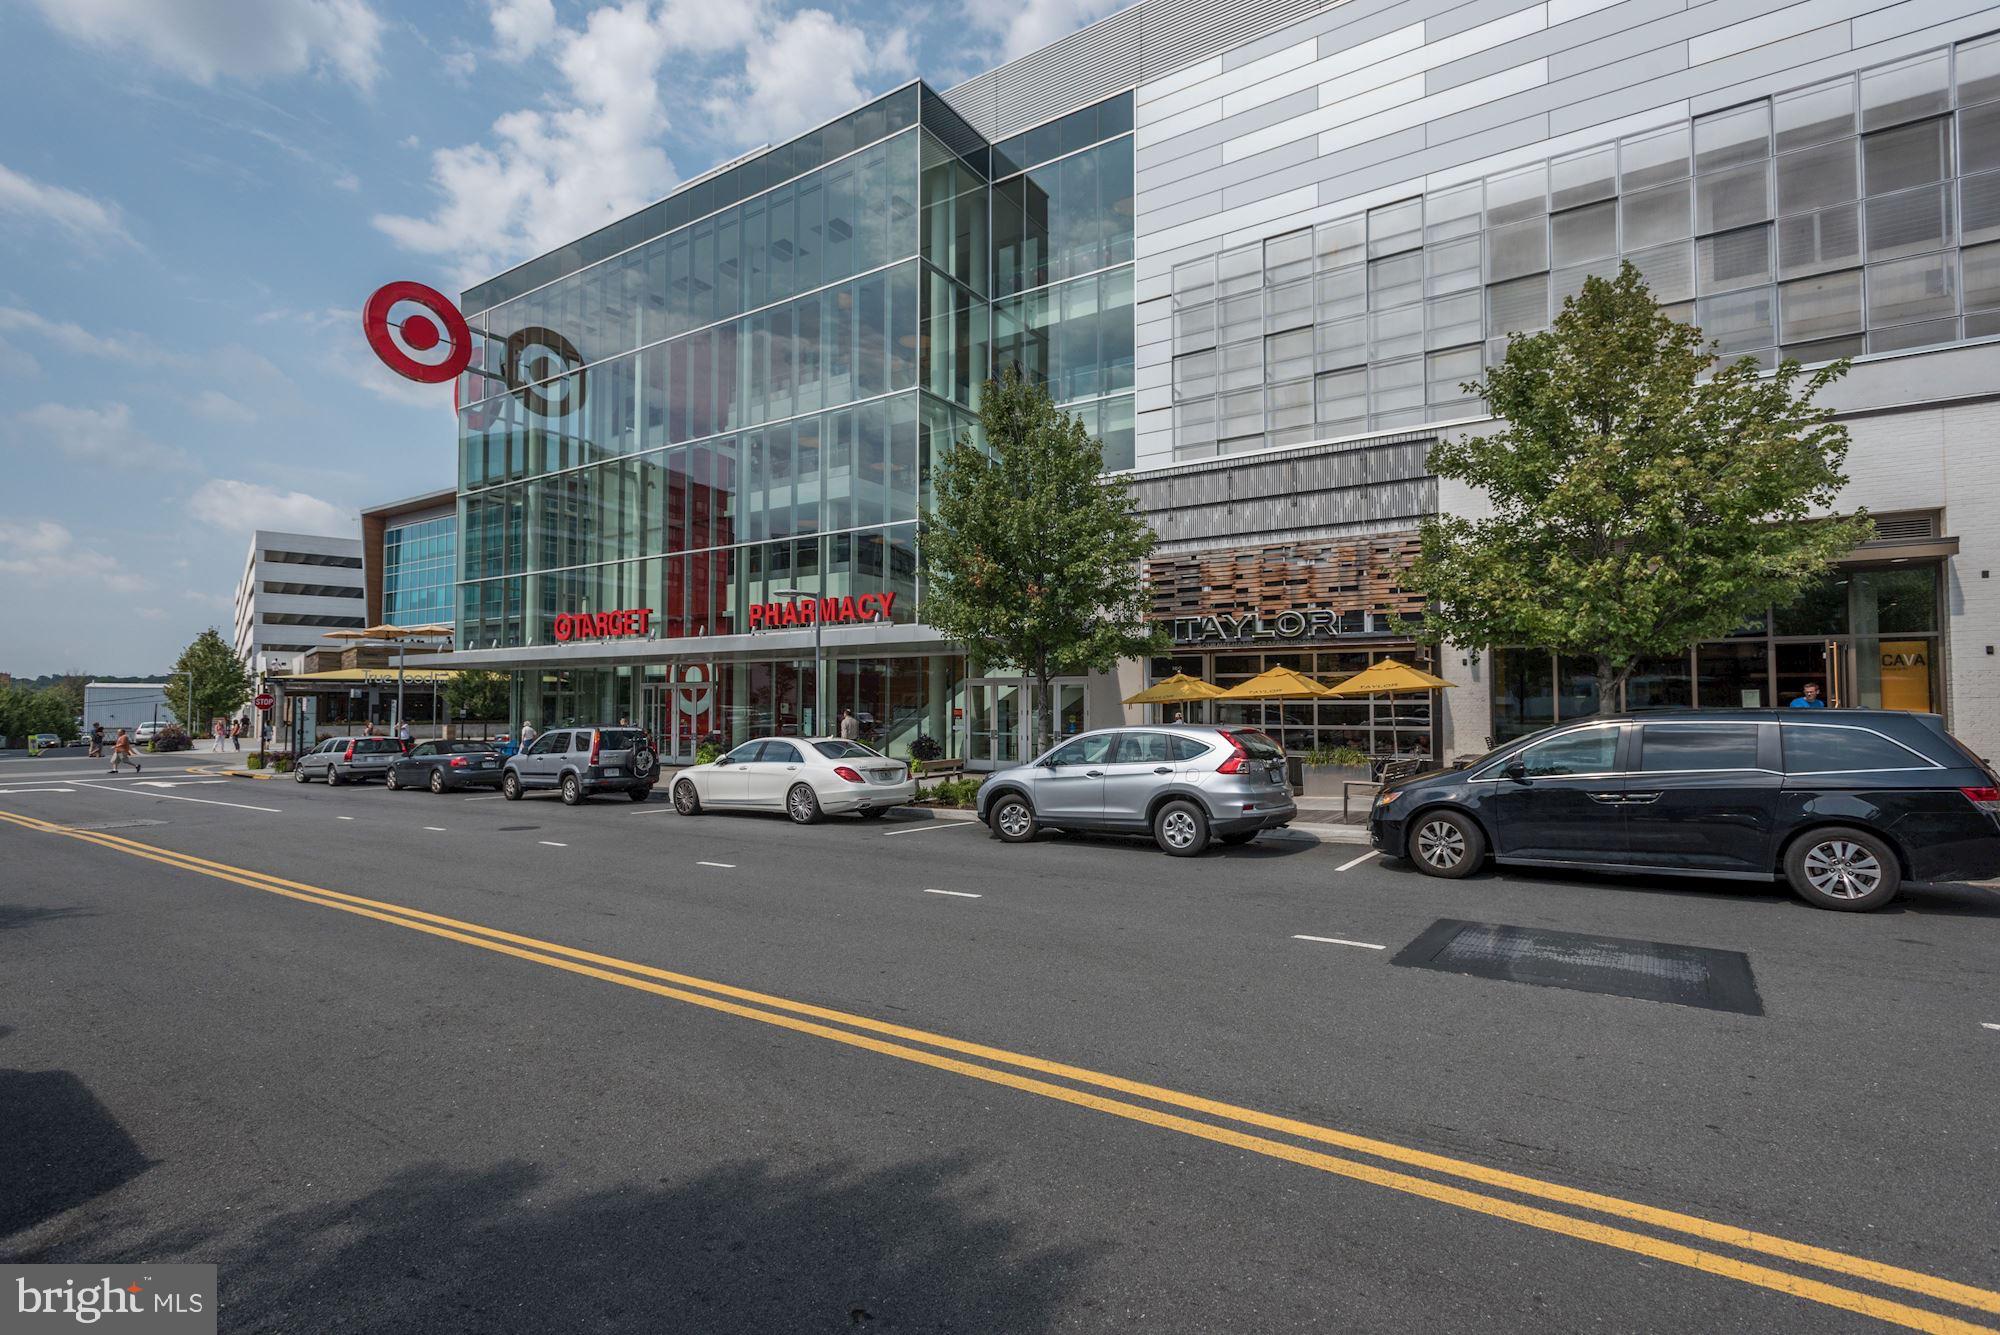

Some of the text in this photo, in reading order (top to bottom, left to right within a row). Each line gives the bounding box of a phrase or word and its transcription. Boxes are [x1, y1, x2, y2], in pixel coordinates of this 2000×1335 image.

[749, 591, 896, 627] PHARMACY
[570, 608, 654, 638] TARGET
[1176, 610, 1338, 641] TAYLOR
[1881, 653, 1926, 666] CAVA
[362, 670, 392, 684] True
[255, 698, 274, 706] STOP
